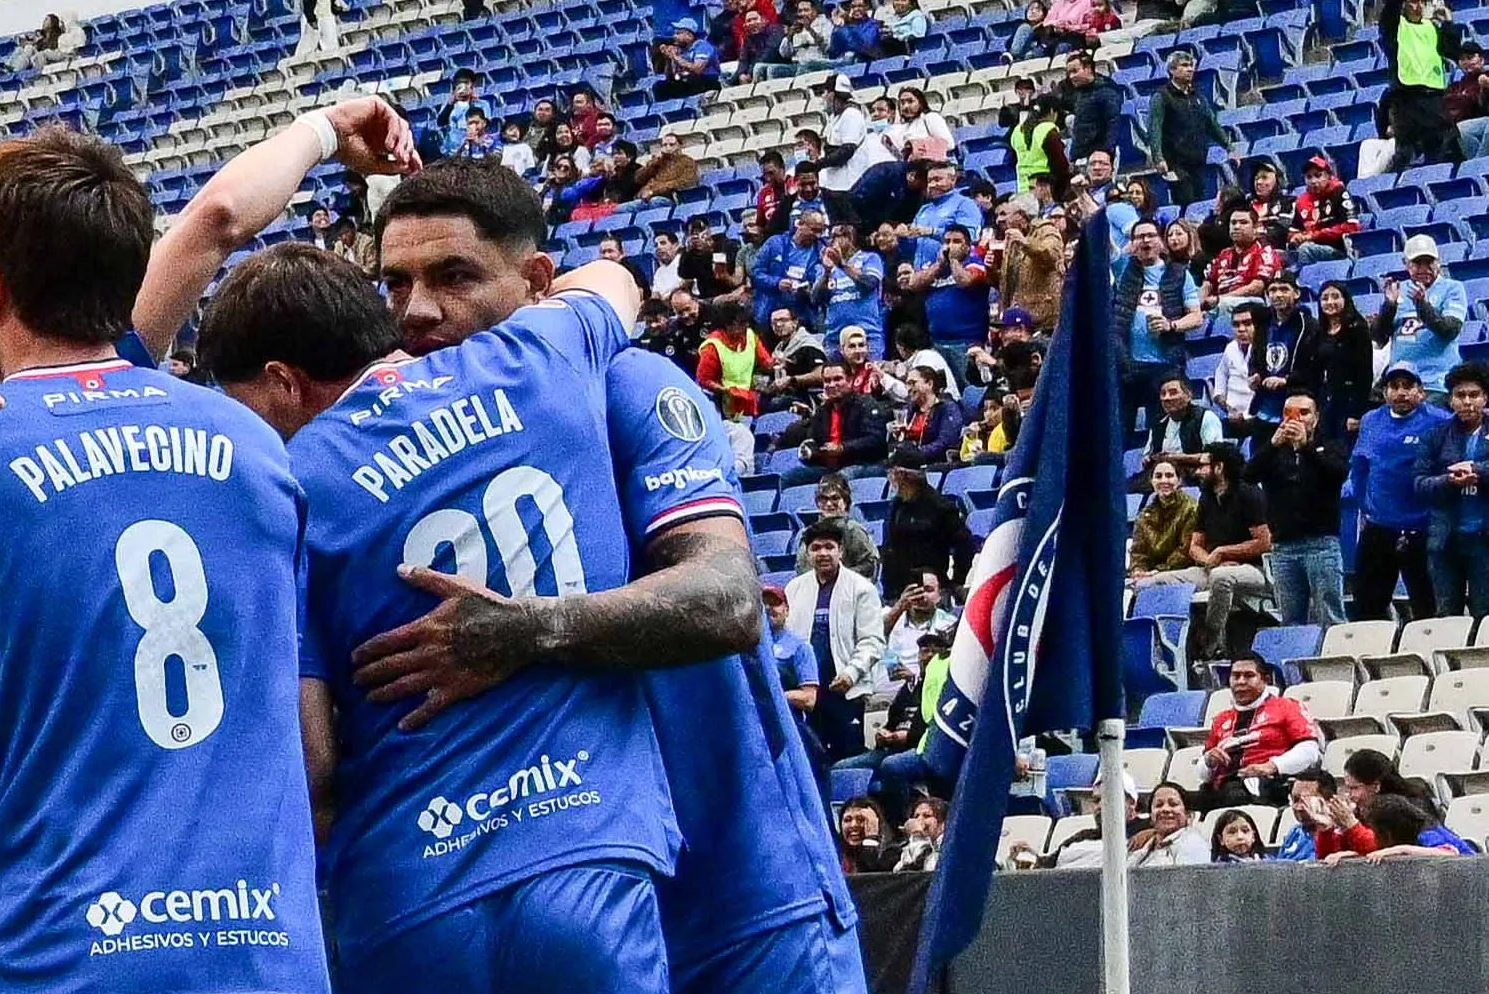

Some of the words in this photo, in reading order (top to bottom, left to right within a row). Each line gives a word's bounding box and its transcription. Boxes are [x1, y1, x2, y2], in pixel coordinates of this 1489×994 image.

[42, 384, 167, 409] PIRMA
[350, 375, 454, 426] PIRMA
[9, 424, 234, 503] PALAVECINO
[351, 388, 524, 504] PARADELA
[115, 519, 224, 750] 8
[466, 754, 583, 821] cemix
[511, 807, 523, 823] Y
[528, 790, 601, 818] ESTUCOS
[140, 879, 276, 923] cemix
[90, 932, 194, 957] ADHESIVOS
[198, 932, 211, 947] Y
[217, 930, 289, 947] ESTUCOS
